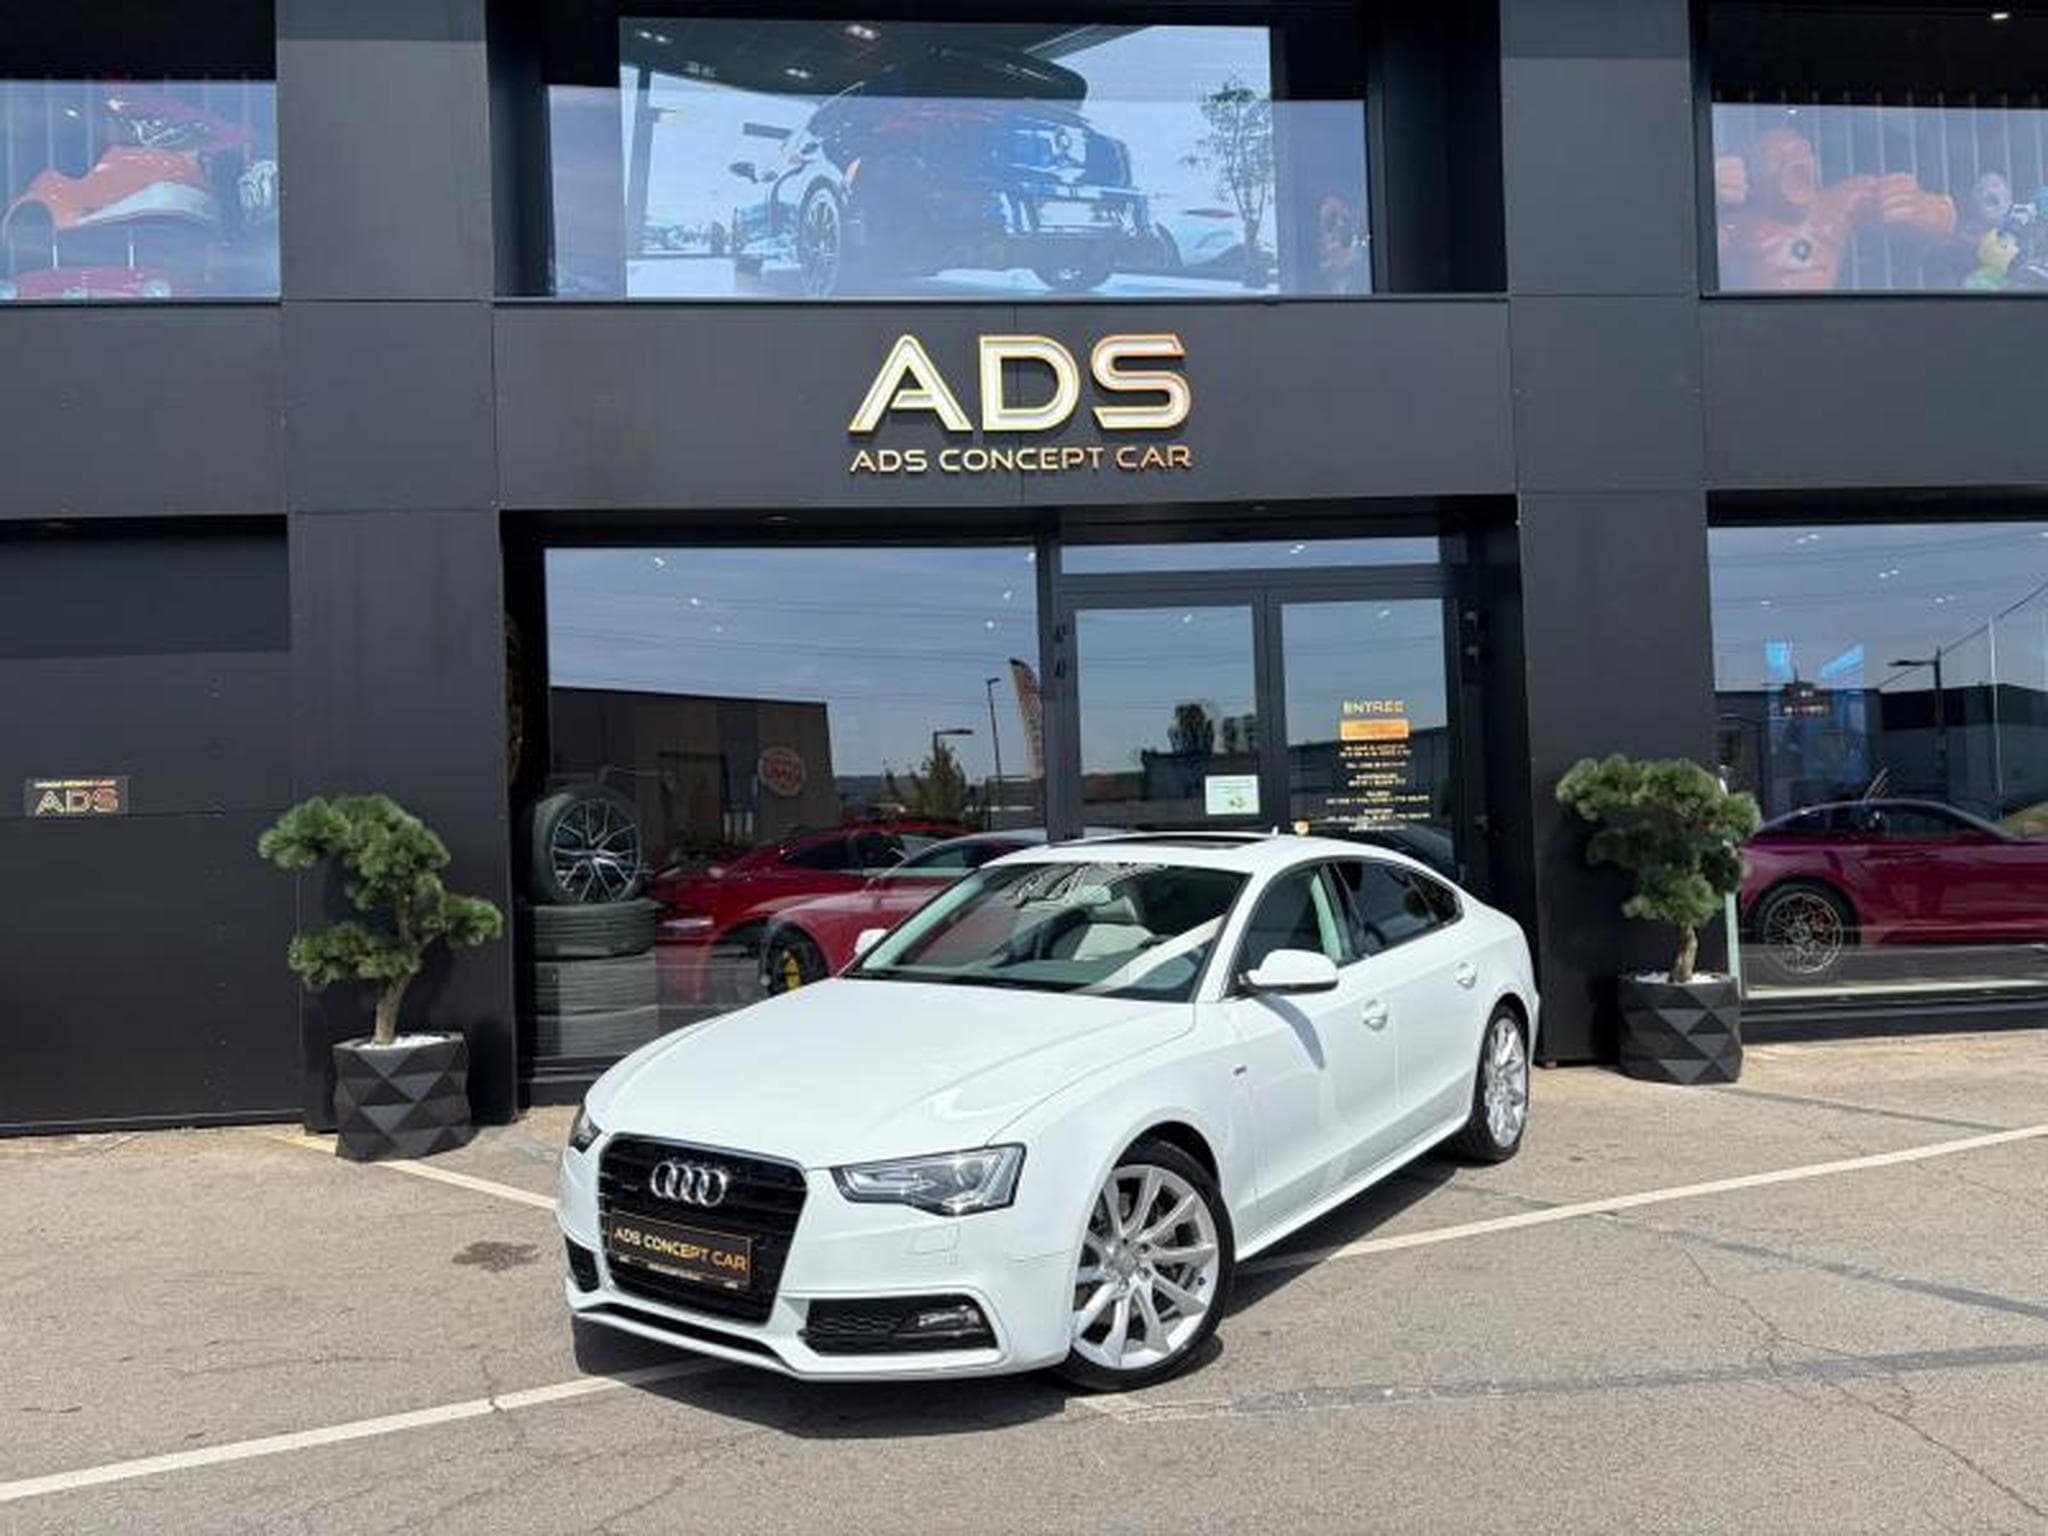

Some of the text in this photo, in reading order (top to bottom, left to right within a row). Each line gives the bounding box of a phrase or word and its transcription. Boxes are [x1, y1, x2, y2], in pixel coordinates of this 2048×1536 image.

[849, 333, 1192, 432] ADS
[850, 445, 1193, 472] ADS CONCEPT CAR
[35, 789, 119, 815] ADS
[613, 1227, 748, 1271] ADS CONCEPT CAR
